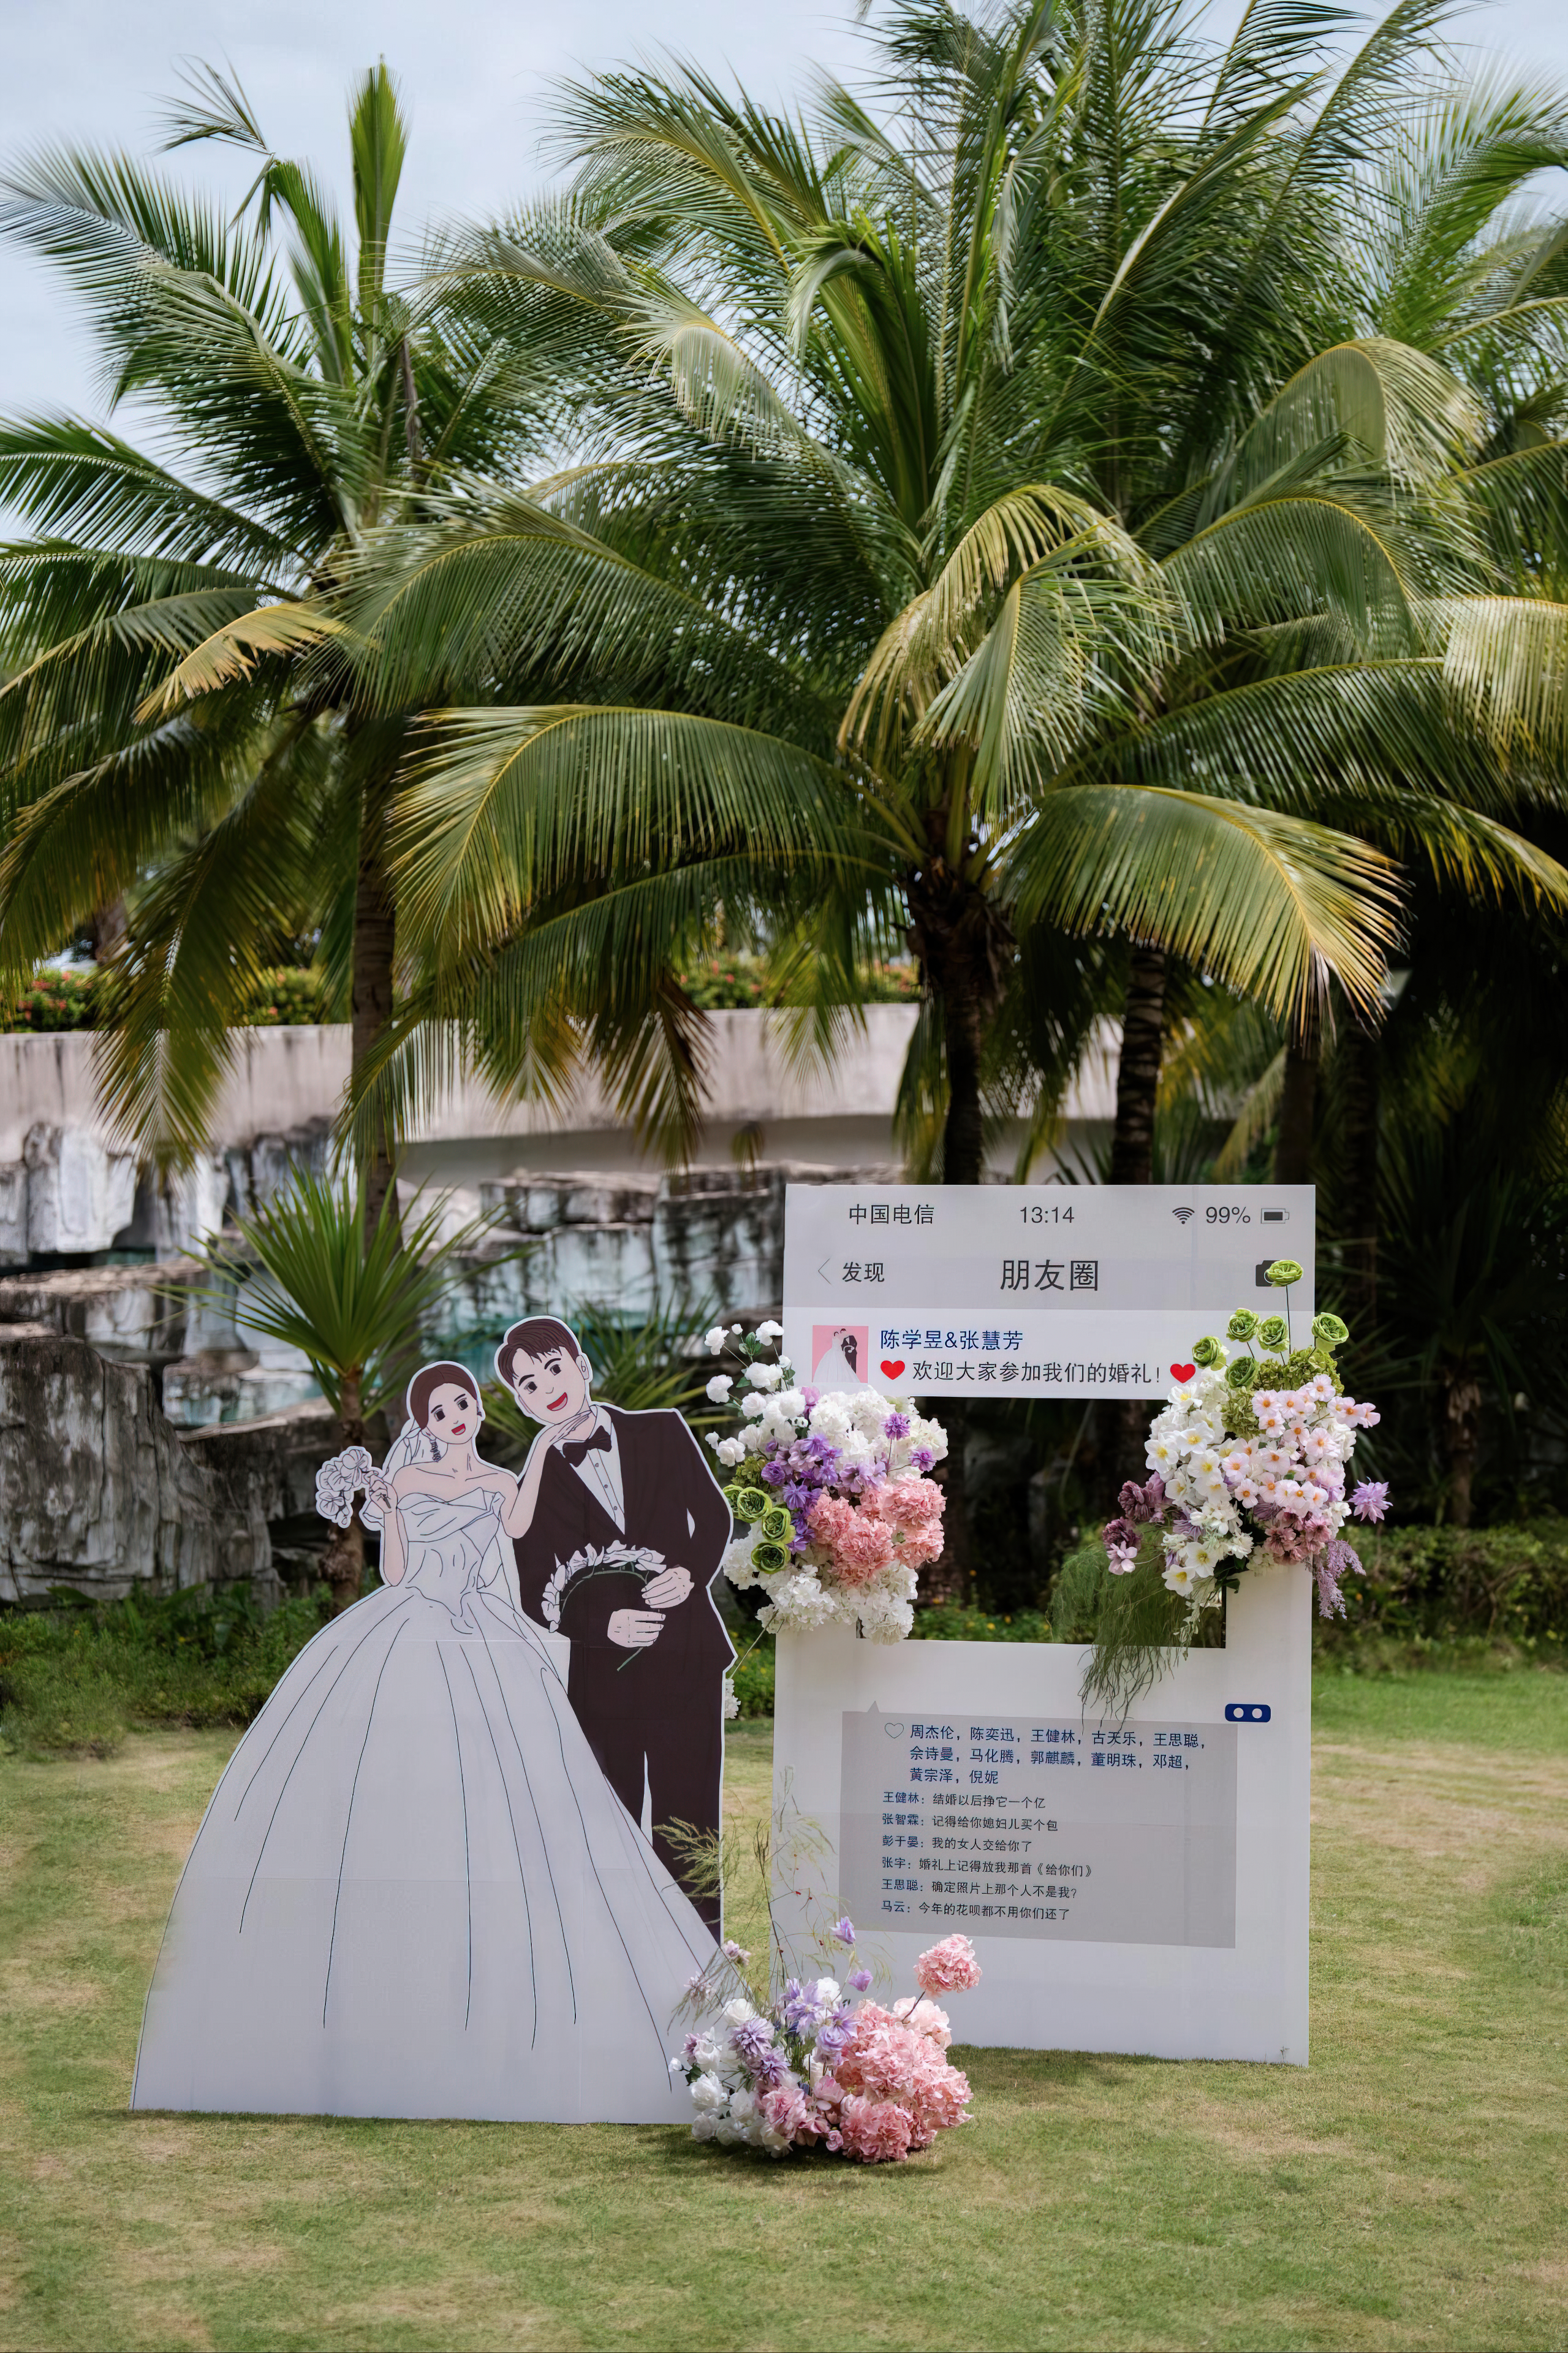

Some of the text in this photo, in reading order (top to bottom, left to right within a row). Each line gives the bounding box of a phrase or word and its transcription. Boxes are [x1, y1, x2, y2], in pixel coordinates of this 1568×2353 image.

[849, 1204, 934, 1225] 中国电信
[1020, 1206, 1075, 1223] 13:14
[1205, 1206, 1251, 1224] 99%
[841, 1261, 885, 1283] 发现
[999, 1259, 1099, 1291] 朋友圈
[881, 1329, 1023, 1351] 陈学昱&张慧芳
